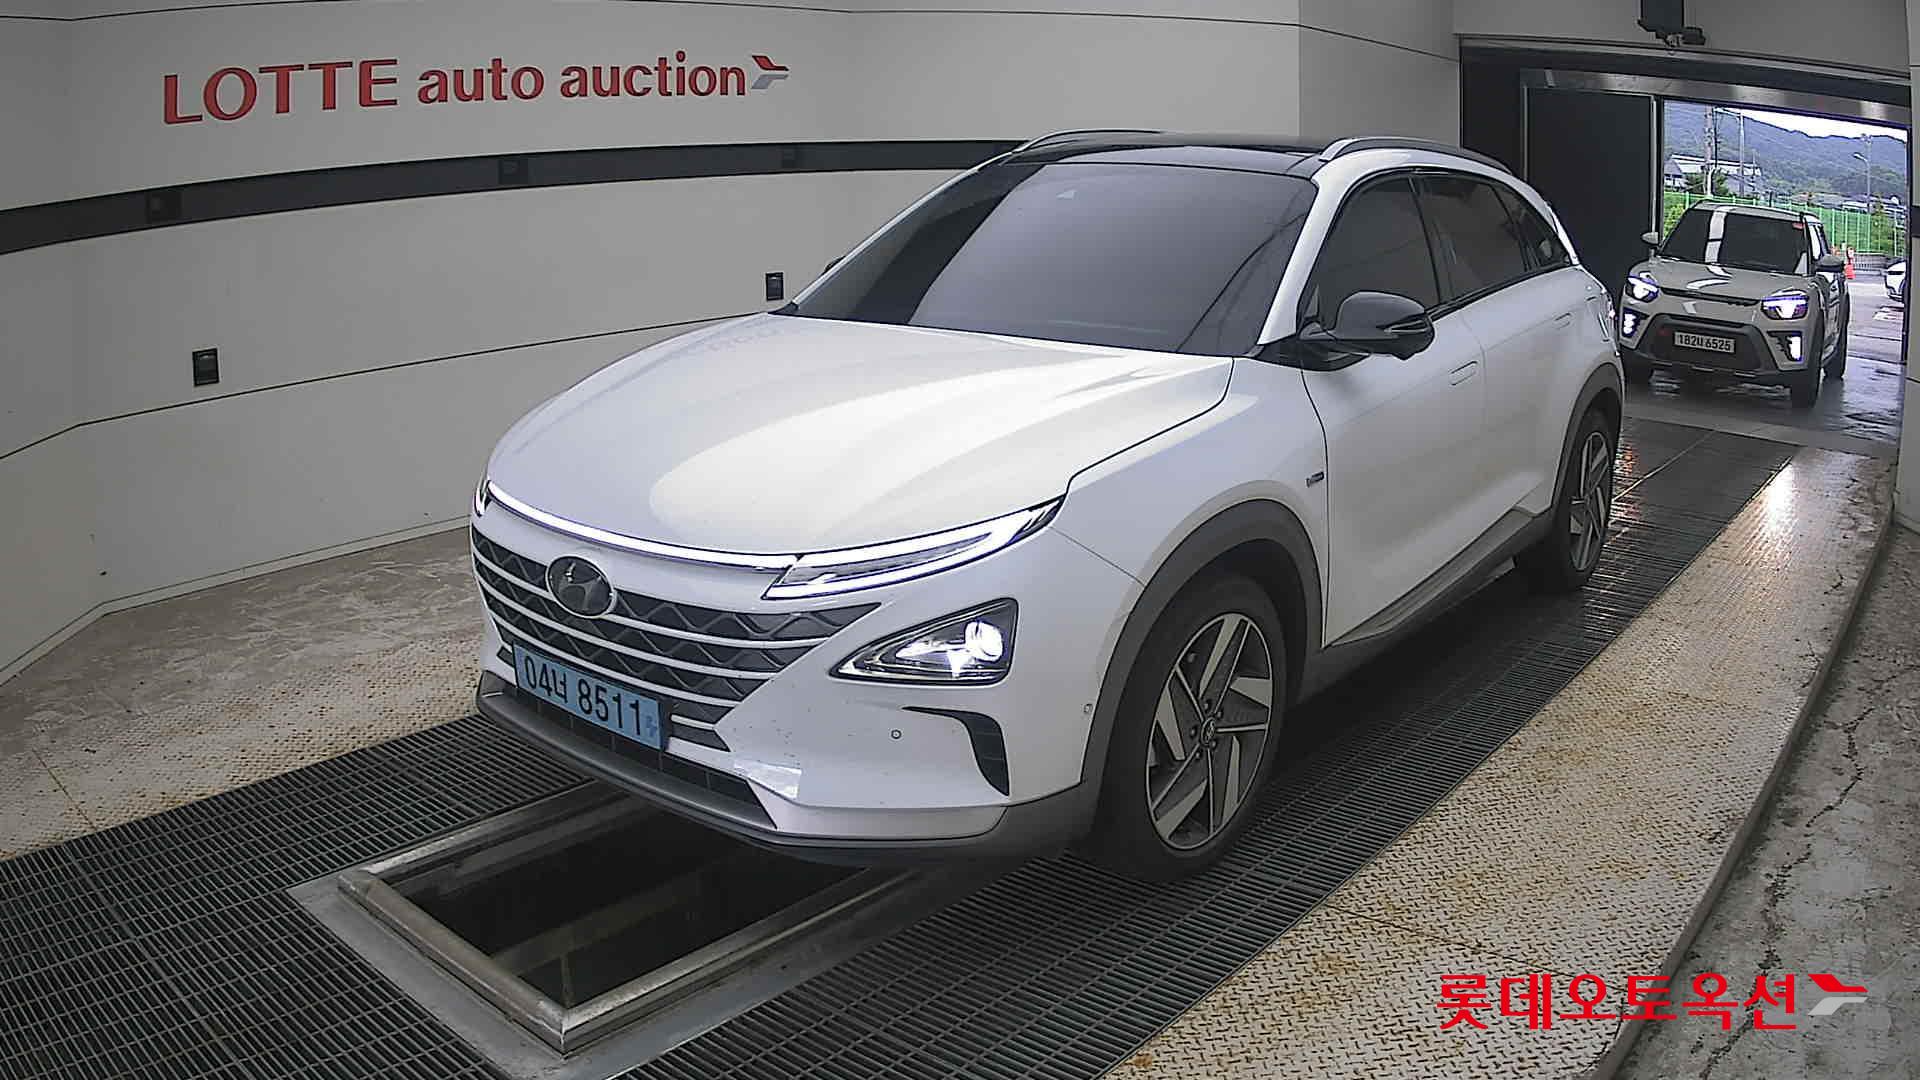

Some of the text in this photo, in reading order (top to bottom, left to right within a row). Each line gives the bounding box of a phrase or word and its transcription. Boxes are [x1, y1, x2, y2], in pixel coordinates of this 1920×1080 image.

[163, 50, 746, 125] LOTTE auto auction
[1705, 338, 1731, 352] 6525
[524, 655, 641, 736] 04너 8511
